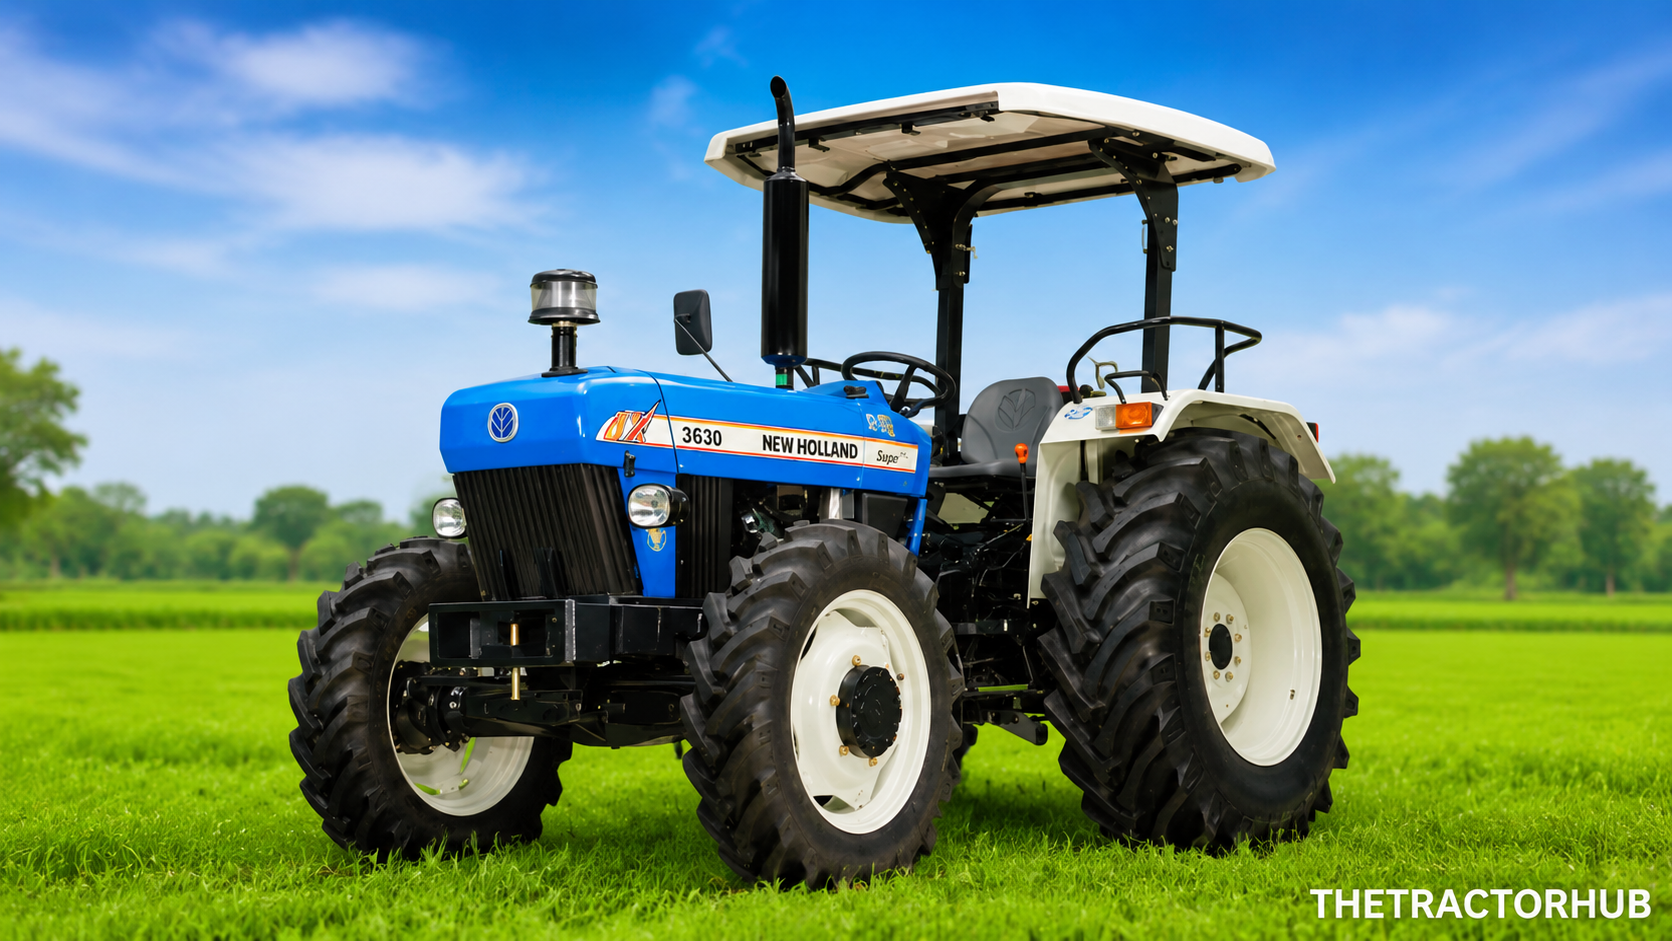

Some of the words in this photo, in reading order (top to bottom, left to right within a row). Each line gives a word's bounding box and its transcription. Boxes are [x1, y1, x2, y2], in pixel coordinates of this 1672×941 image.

[682, 426, 722, 447] 3630
[762, 434, 794, 454] NEW
[797, 438, 858, 459] HOLLAND
